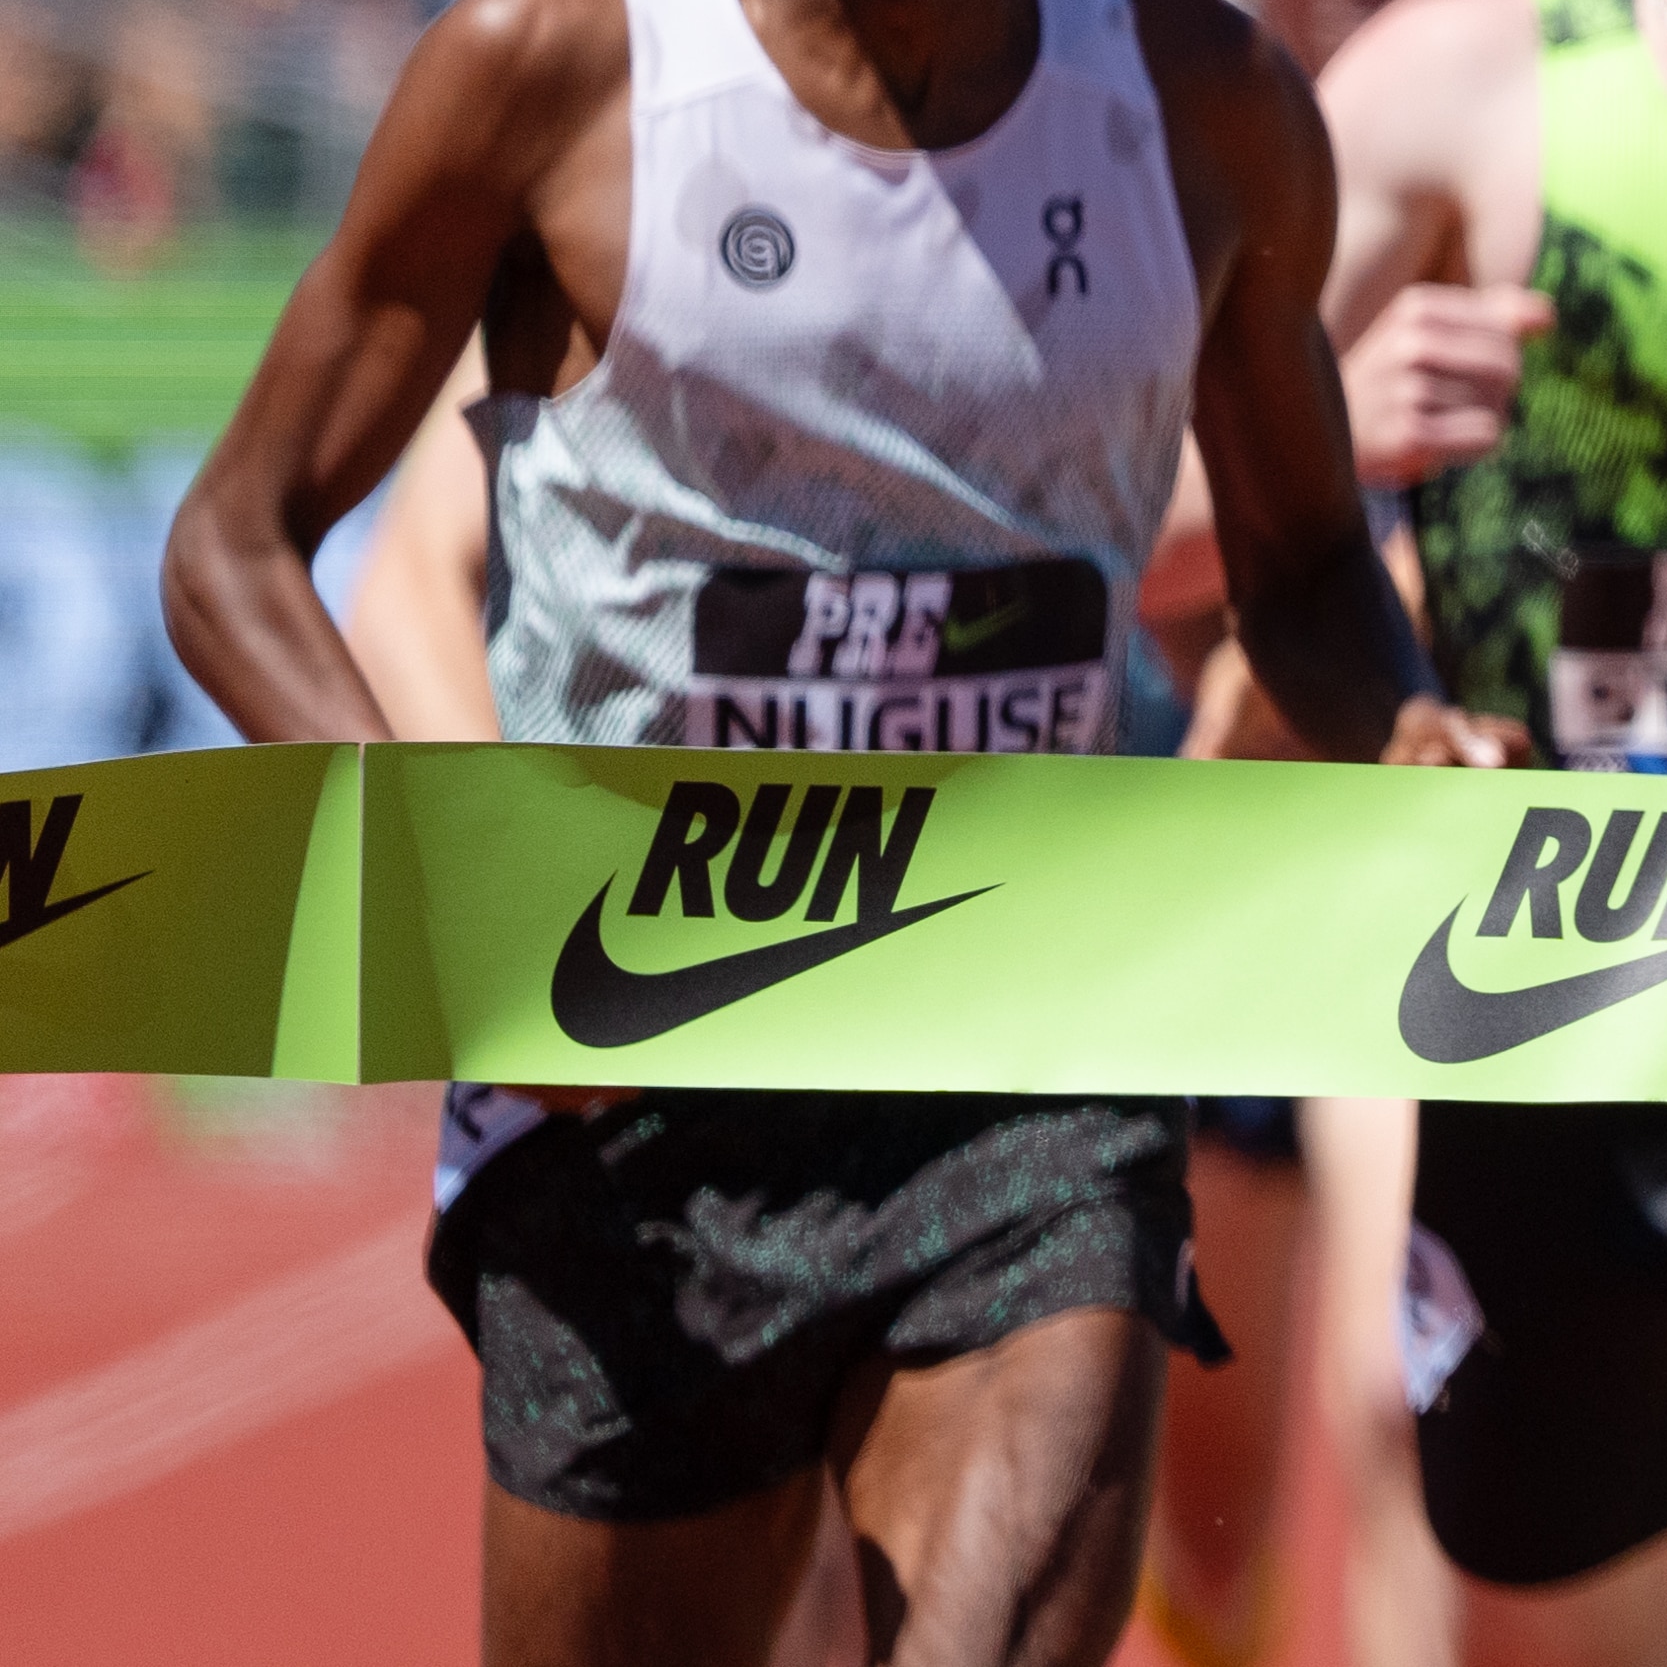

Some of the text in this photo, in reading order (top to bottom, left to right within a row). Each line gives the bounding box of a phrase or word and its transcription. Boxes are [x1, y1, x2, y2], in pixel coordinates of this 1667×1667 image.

[788, 570, 953, 678] PRE
[714, 679, 1087, 752] NUGUSE
[626, 781, 936, 924] RUN
